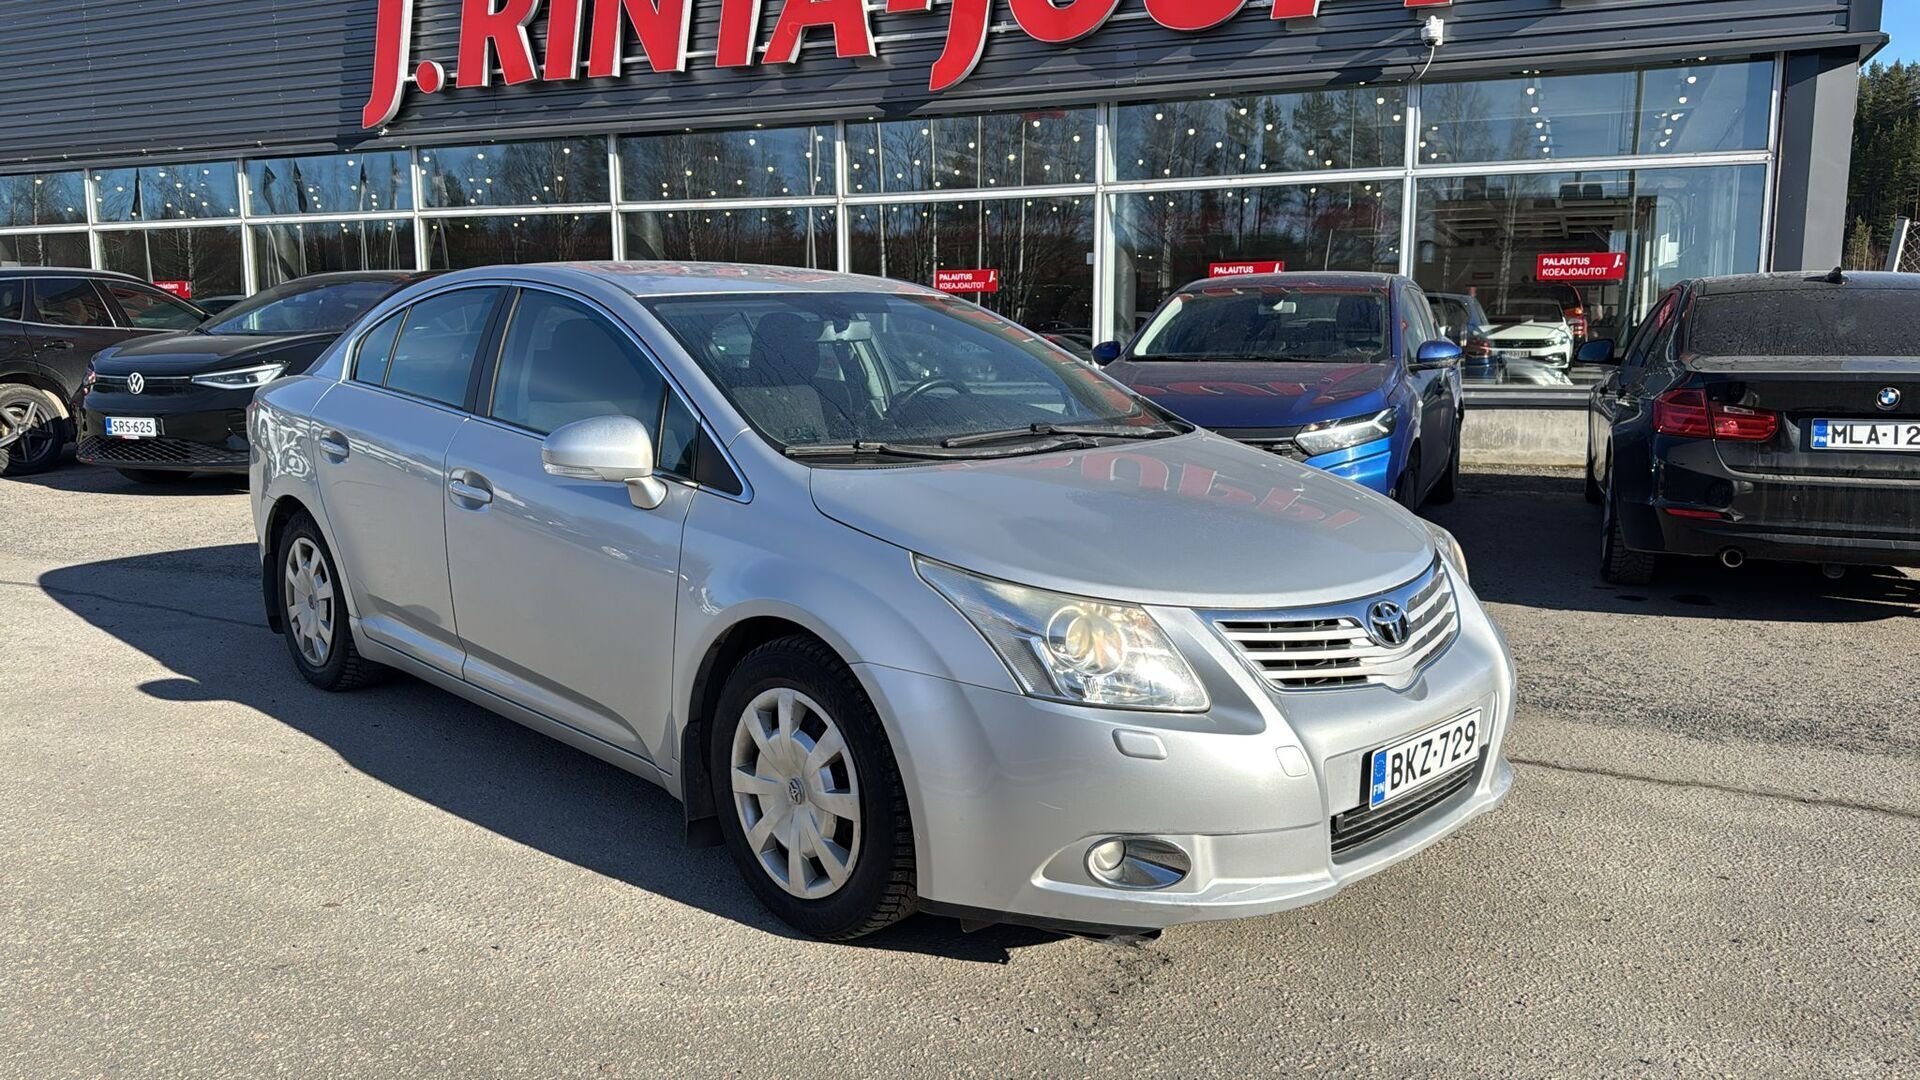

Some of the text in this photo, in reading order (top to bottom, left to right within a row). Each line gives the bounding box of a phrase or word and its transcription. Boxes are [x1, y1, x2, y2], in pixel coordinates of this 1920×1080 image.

[1542, 257, 1590, 266] PALAUTUS
[1213, 266, 1254, 275] PALAUTUS
[1542, 267, 1607, 276] KOEAJOAUTOT
[939, 273, 973, 281] PALAUTUS
[939, 281, 985, 290] KOEAJOAUTOT
[112, 420, 153, 433] SRS-625
[1390, 720, 1477, 791] BKZ-729
[1373, 782, 1385, 797] FIN
